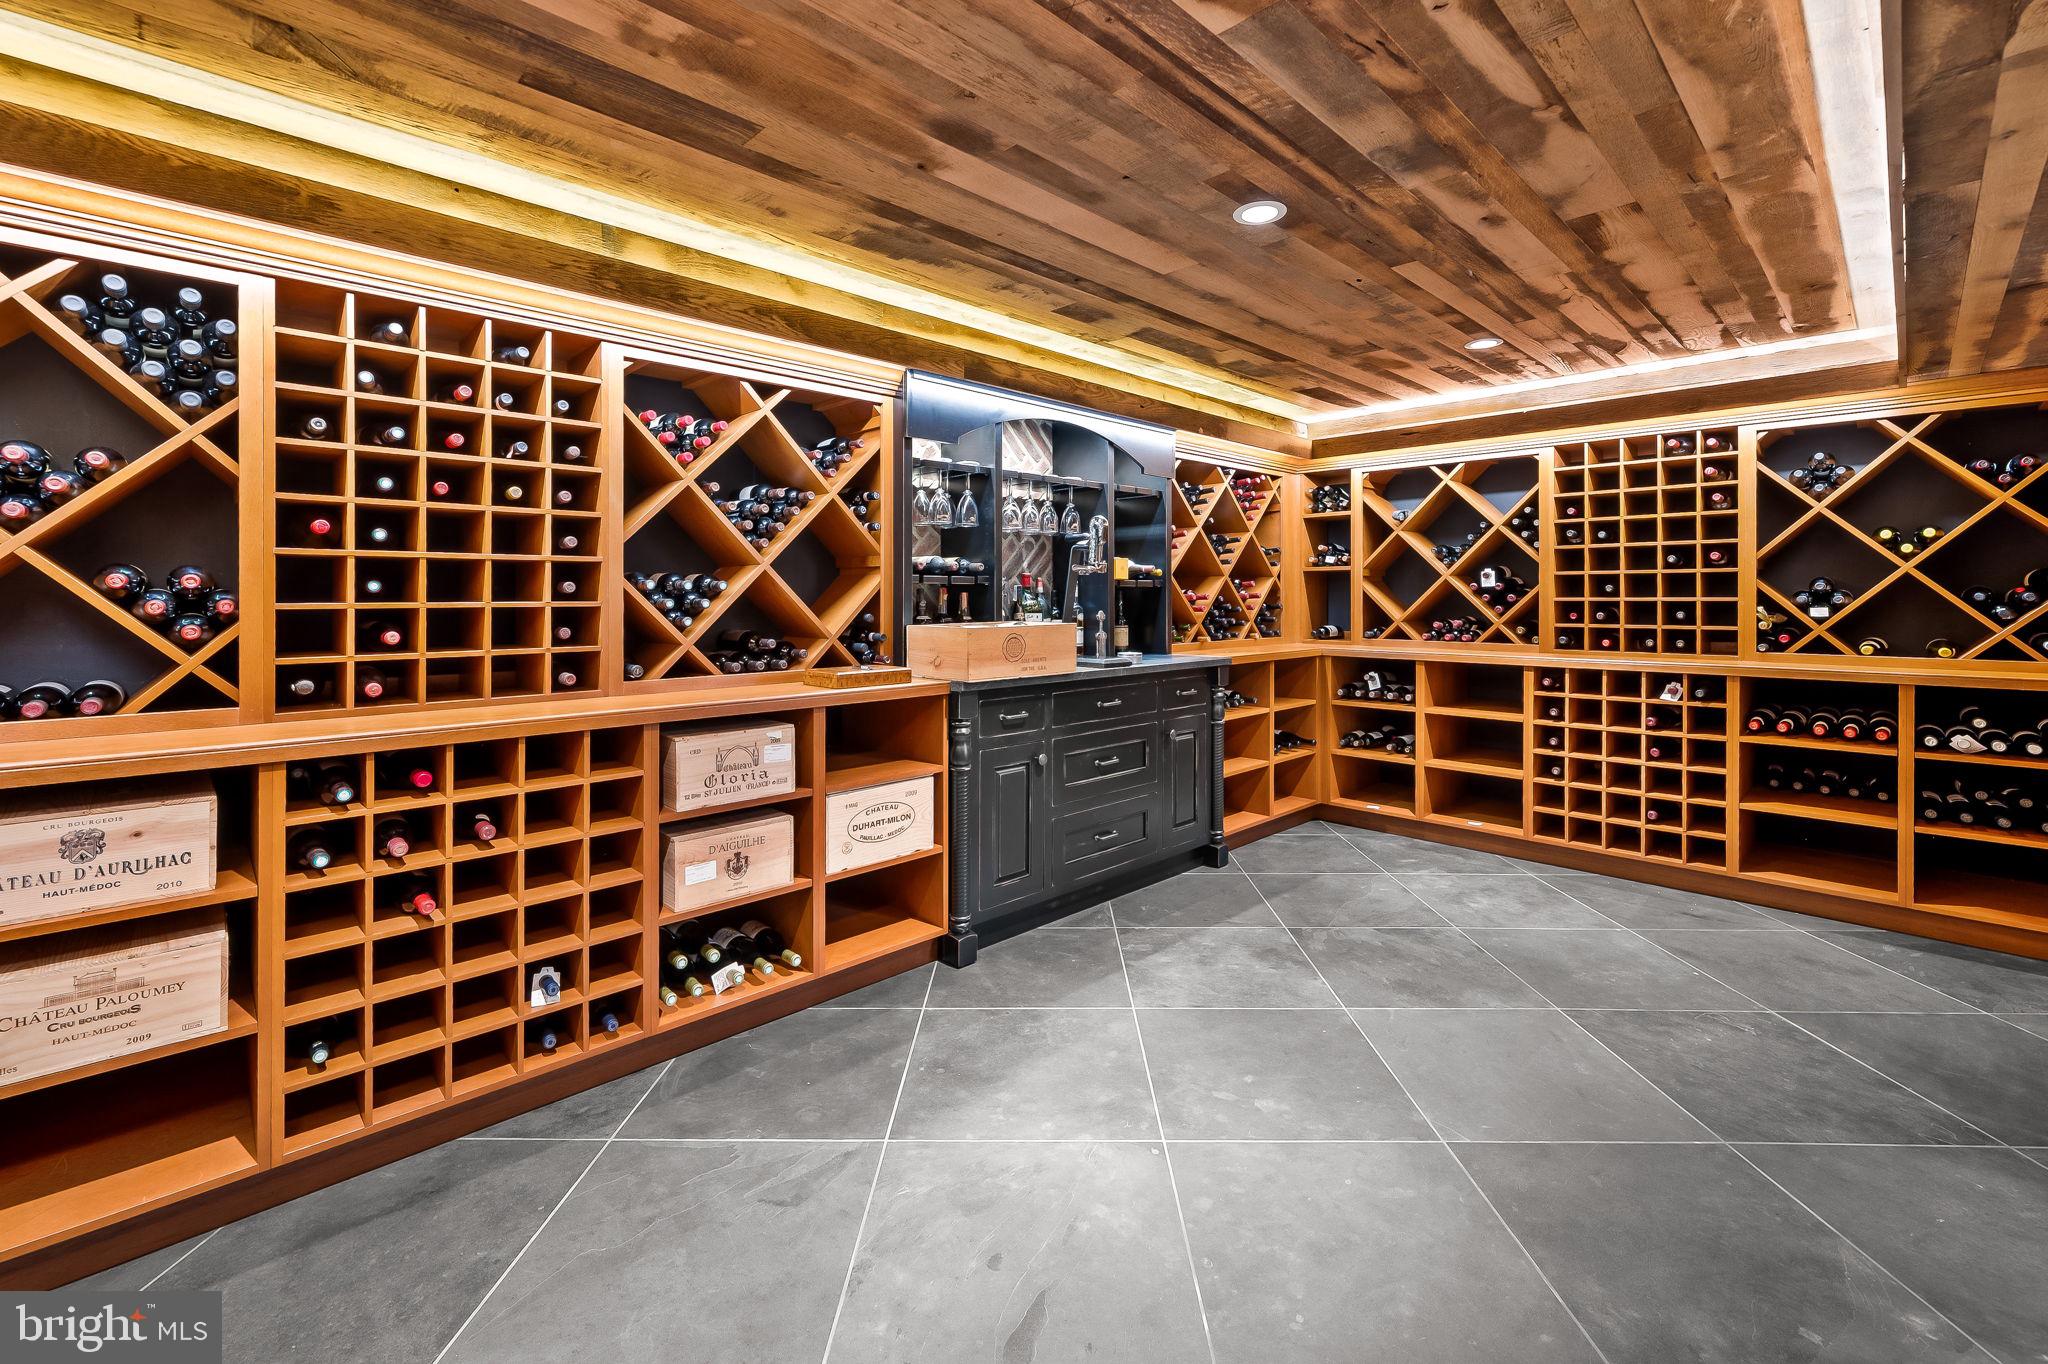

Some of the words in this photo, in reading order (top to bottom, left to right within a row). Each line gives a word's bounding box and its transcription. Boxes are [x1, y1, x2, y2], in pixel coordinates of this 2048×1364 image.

[704, 769, 769, 788] Gloria
[714, 785, 741, 796] JULIEN
[42, 823, 62, 831] CRU
[68, 816, 124, 828] BOURGEOIS
[852, 813, 912, 832] DUHART-MILON
[709, 836, 766, 854] D'AIGUILHE
[74, 851, 192, 881] D'AURILHAC
[42, 880, 122, 899] HAUT-MÉDOC
[156, 880, 183, 891] 2010
[0, 1003, 88, 1032] CHÂTEAU
[96, 981, 186, 1011] PALOUMEY
[47, 1021, 75, 1032] CRU
[78, 1004, 142, 1025] BOURGEOIS
[126, 1033, 152, 1045] 2009
